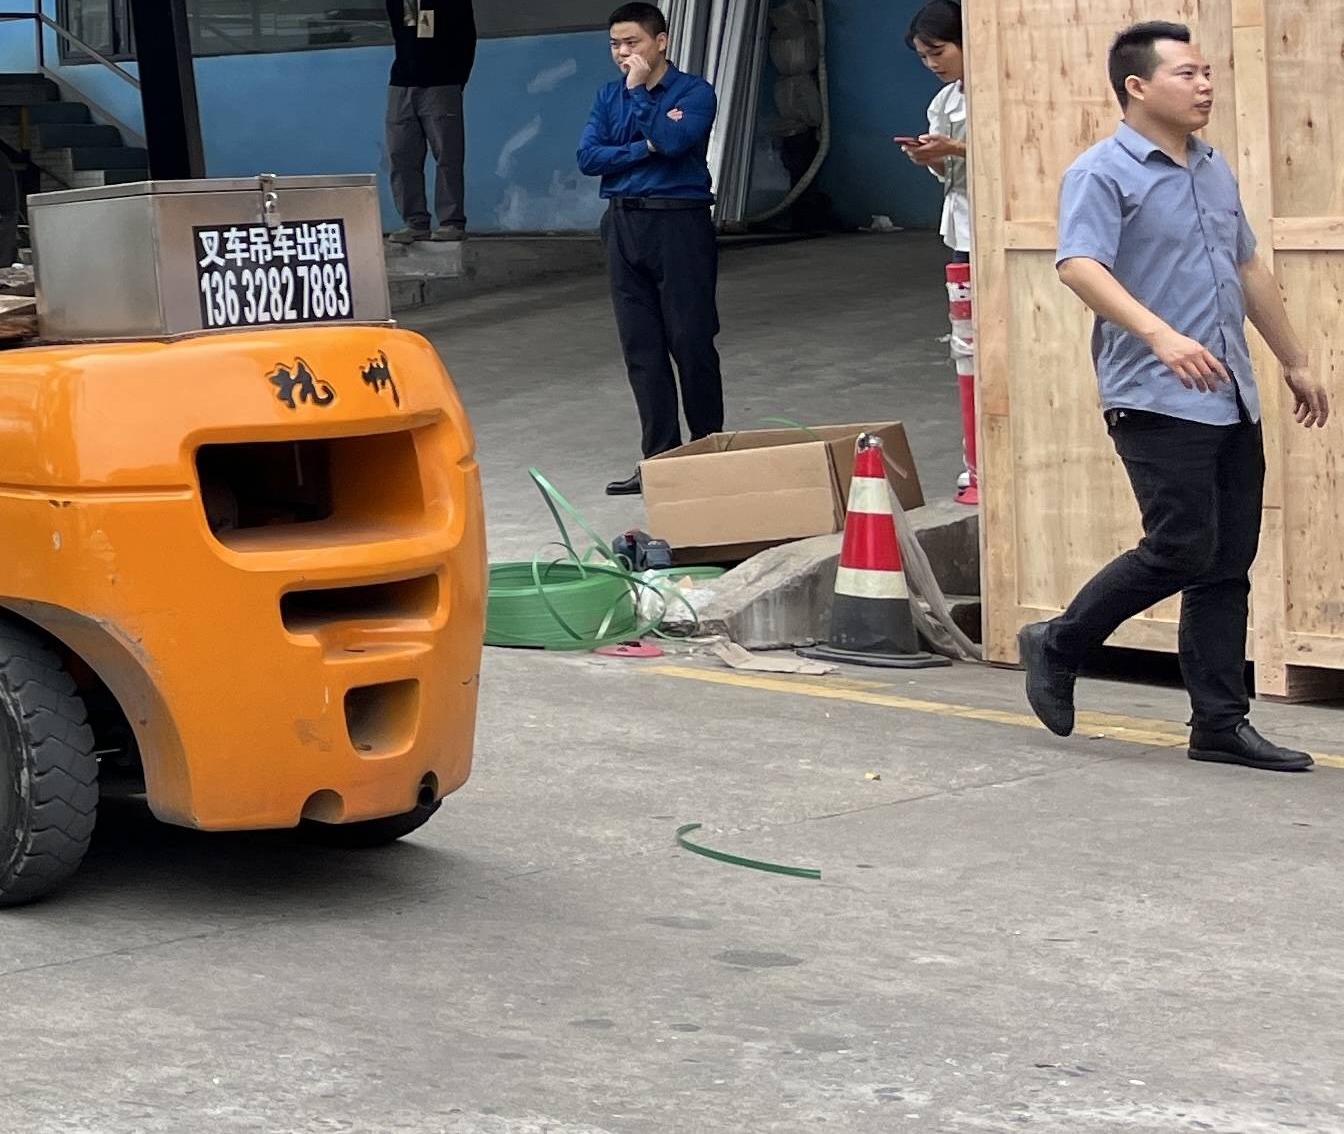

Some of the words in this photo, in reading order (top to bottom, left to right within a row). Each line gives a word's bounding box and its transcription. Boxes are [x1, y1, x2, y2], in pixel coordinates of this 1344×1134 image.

[198, 222, 345, 268] 叉车吊车出租
[201, 270, 241, 326] 136
[241, 266, 298, 323] 3282
[297, 263, 350, 318] 7883
